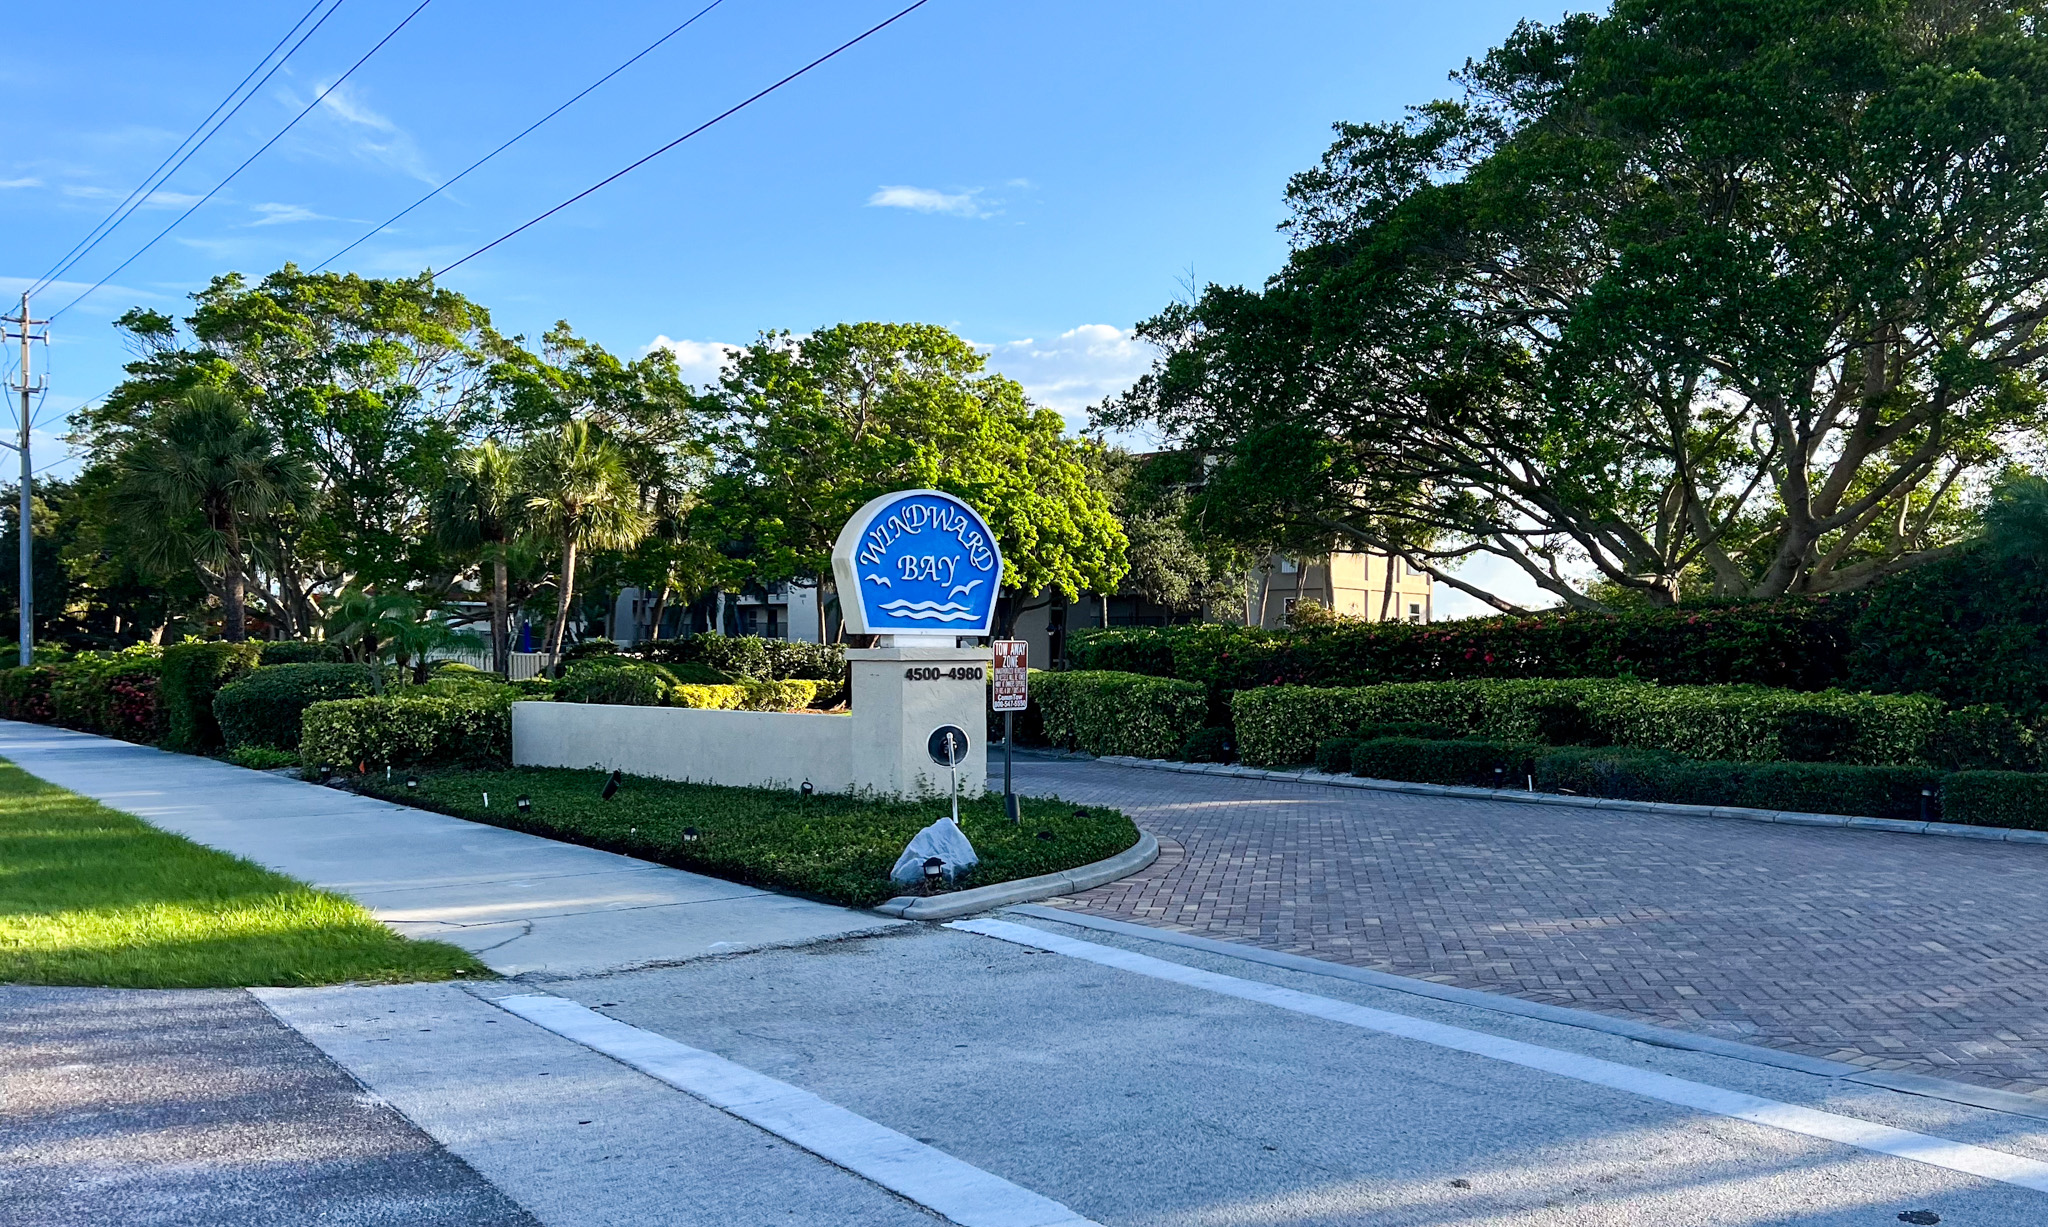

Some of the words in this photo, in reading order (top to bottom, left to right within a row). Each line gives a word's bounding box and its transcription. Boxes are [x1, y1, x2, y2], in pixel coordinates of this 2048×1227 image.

[860, 504, 994, 572] WINDWARD
[897, 554, 961, 588] BAY
[995, 643, 1008, 655] TOW
[1010, 643, 1026, 655] AWAY
[1002, 655, 1018, 667] ZONE
[905, 667, 983, 681] 4500-4980
